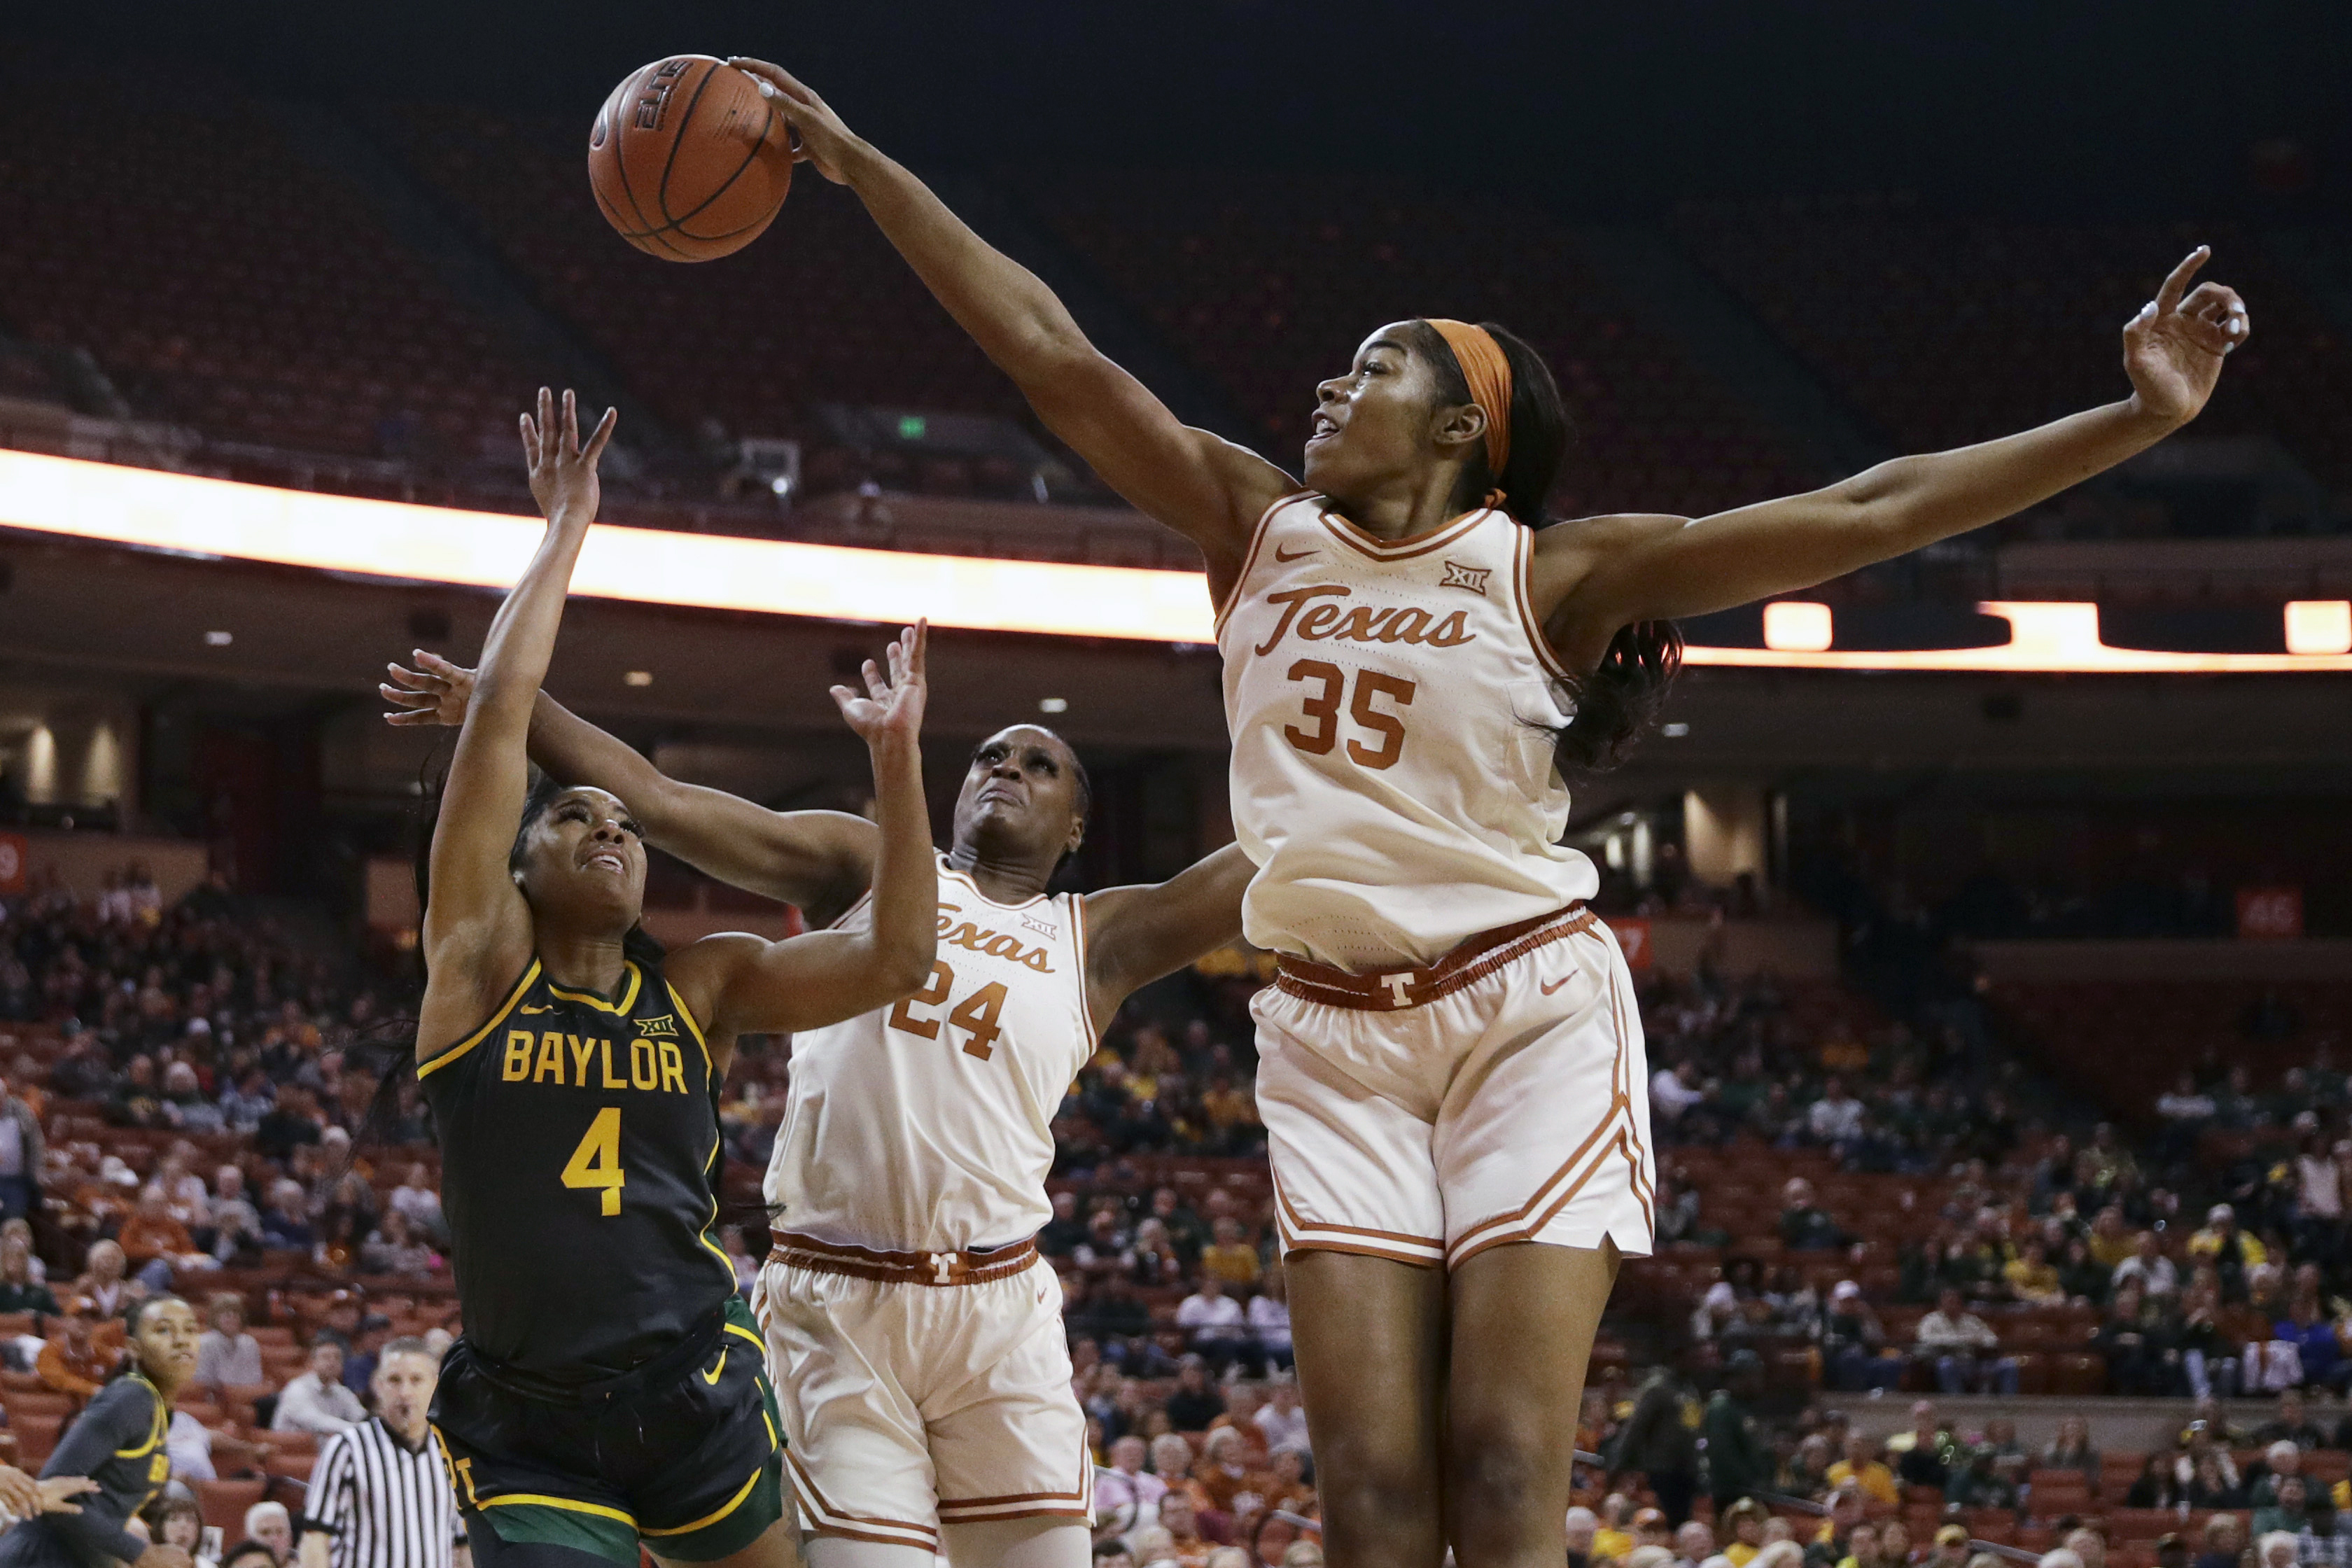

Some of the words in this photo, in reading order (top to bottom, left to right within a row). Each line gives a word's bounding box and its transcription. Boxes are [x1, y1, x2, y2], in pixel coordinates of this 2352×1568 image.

[1255, 585, 1476, 657] Texas
[1284, 658, 1415, 771] 35
[889, 960, 1008, 1061] 24
[1380, 972, 1415, 1007] T
[502, 1029, 689, 1095] BAYLOR
[561, 1107, 626, 1217] 4
[930, 1252, 958, 1284] T
